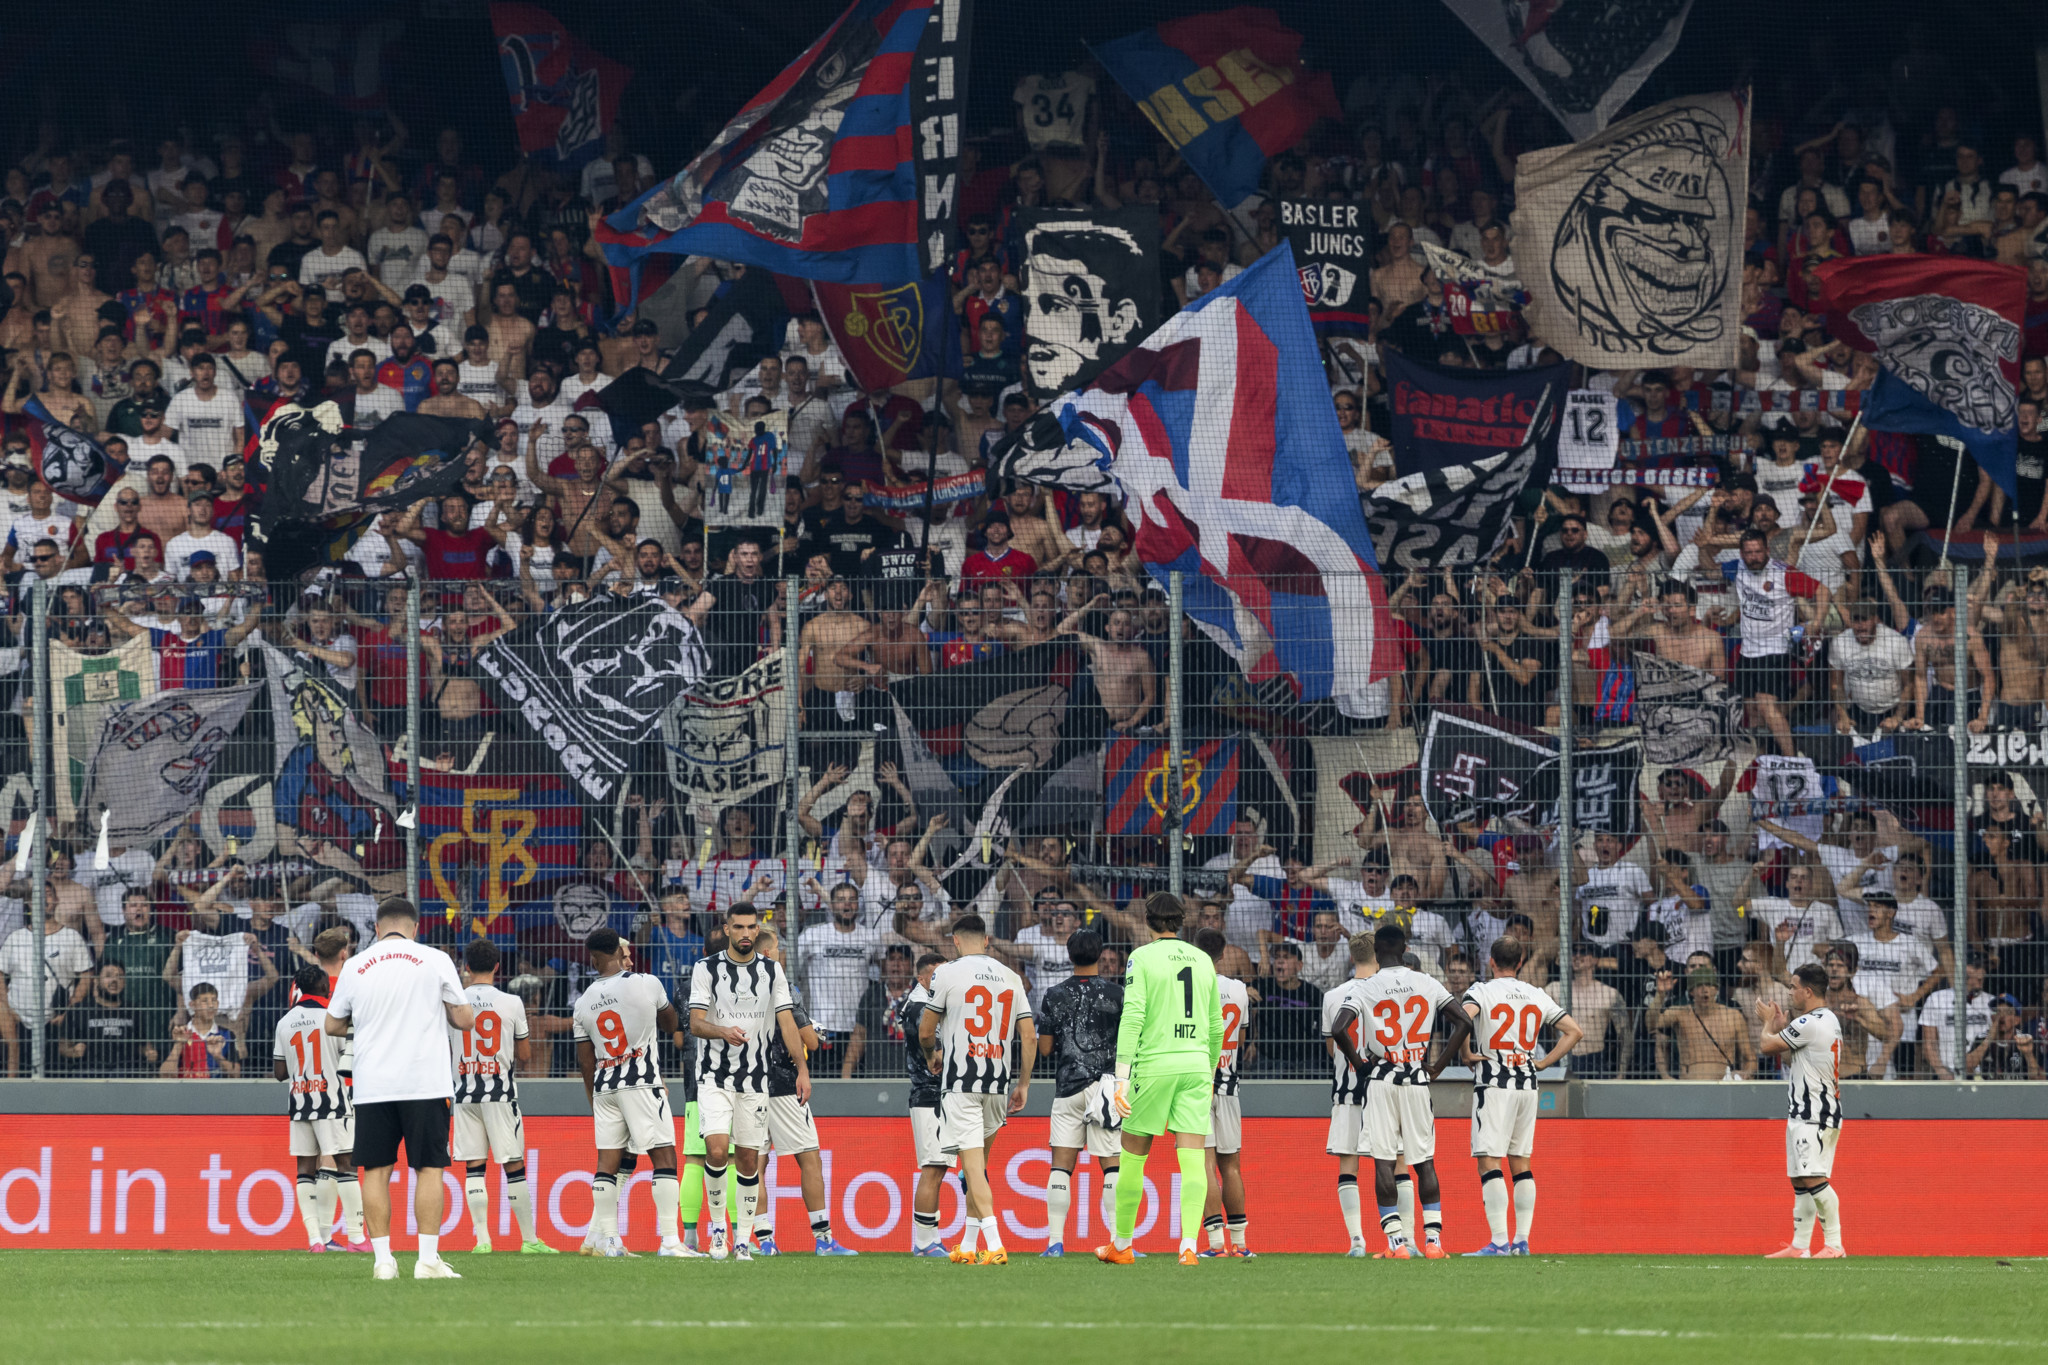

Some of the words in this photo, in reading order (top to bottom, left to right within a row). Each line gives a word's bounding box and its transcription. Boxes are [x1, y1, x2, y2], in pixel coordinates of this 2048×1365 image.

[1032, 93, 1075, 127] 34
[1281, 201, 1358, 228] BASLER
[1304, 232, 1365, 258] JUNGS
[1711, 390, 1846, 412] BASEL
[1569, 407, 1606, 446] 12
[881, 554, 916, 567] EWIG
[881, 566, 915, 578] TREU
[676, 757, 769, 794] BASEL
[1767, 774, 1808, 801] 12
[357, 957, 377, 975] Sali
[379, 951, 424, 967] zämme!
[1168, 953, 1197, 963] GISADA
[974, 973, 1005, 984] GISADA
[1384, 985, 1414, 996] GISADA
[590, 996, 619, 1012] GISADA
[1176, 966, 1193, 1019] 1
[290, 1018, 316, 1029] GISADA
[964, 984, 1014, 1041] 31
[1373, 994, 1430, 1047] 32
[461, 1010, 502, 1057] 19
[596, 1009, 629, 1058] 9
[1174, 1023, 1196, 1039] HITZ
[1221, 1003, 1242, 1051] 2
[1489, 1003, 1543, 1051] 20
[289, 1028, 322, 1077] 11
[90, 1147, 167, 1235] in
[764, 1150, 967, 1252] Hop
